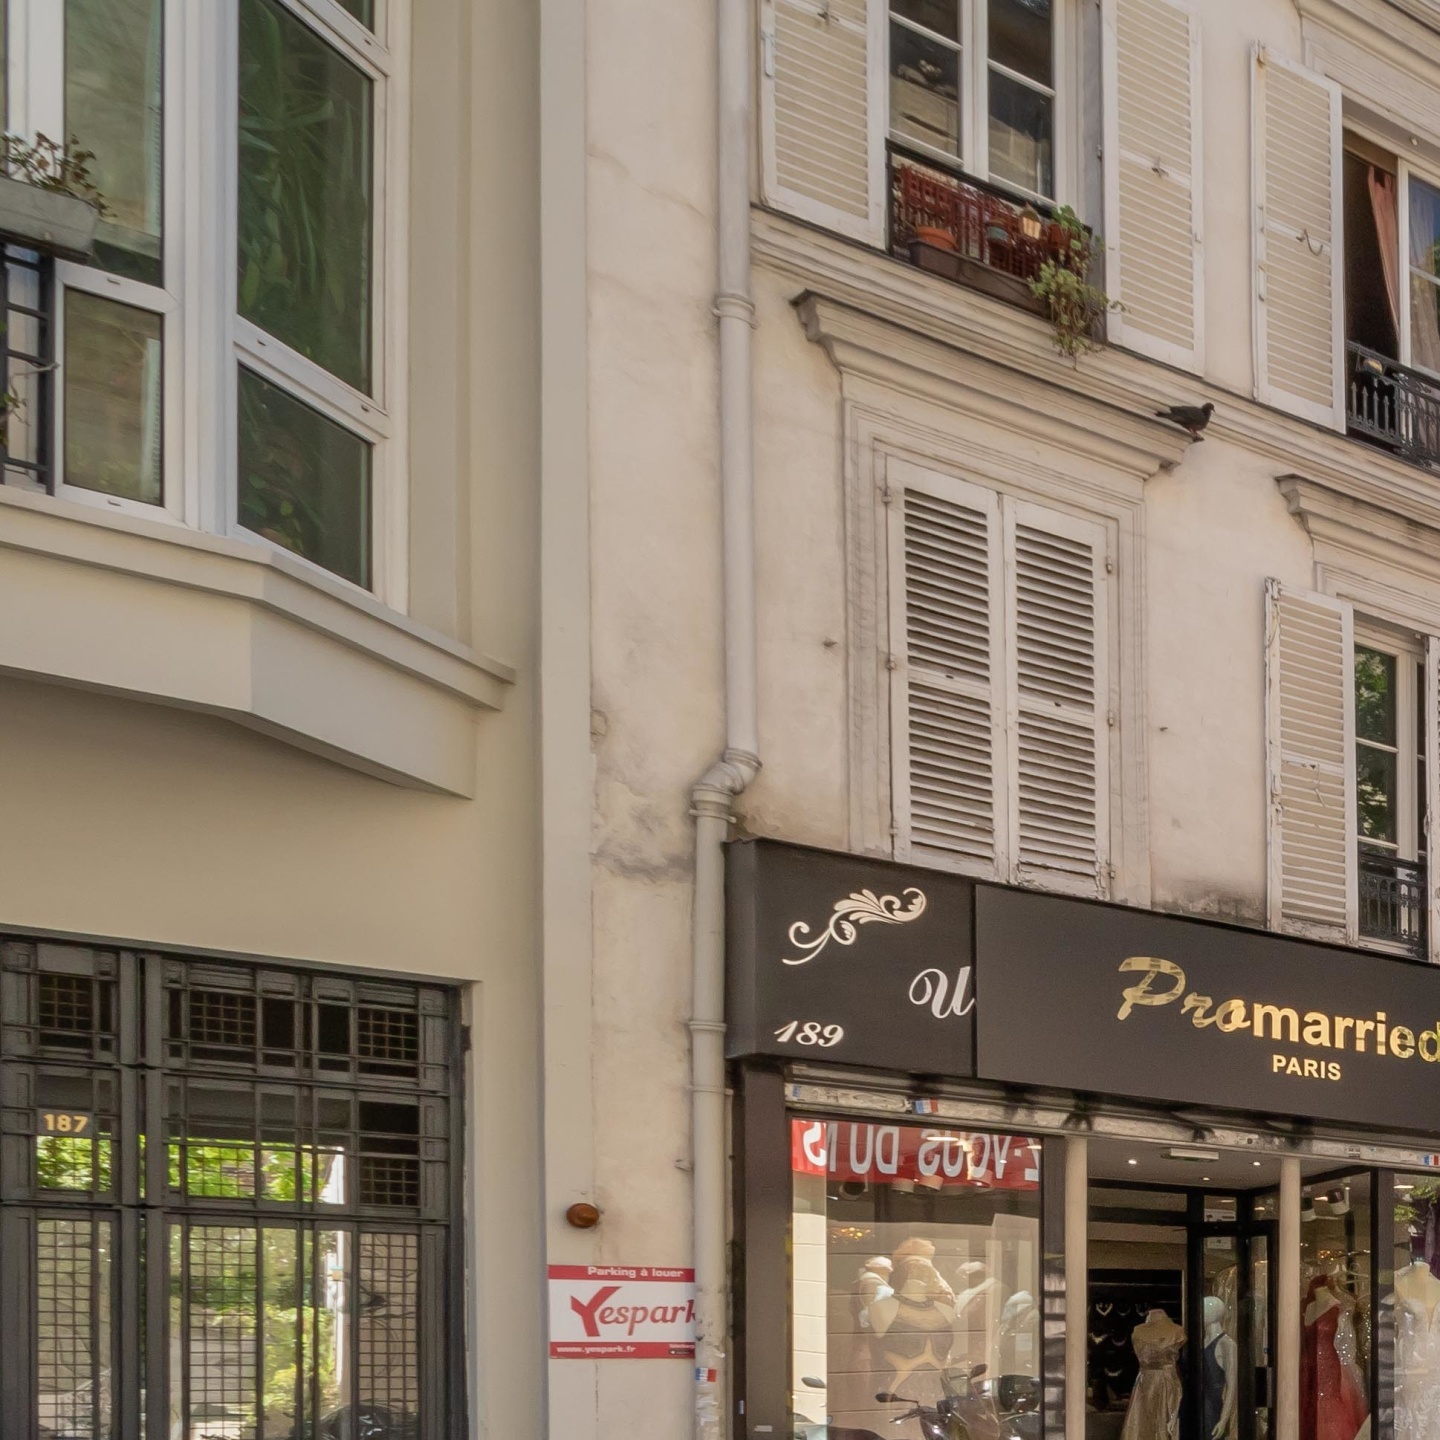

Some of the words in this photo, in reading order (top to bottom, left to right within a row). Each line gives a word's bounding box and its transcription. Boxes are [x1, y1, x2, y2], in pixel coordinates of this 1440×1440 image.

[773, 1019, 844, 1049] 189
[1272, 1053, 1342, 1082] PARIS
[43, 1113, 88, 1133] 187
[587, 1266, 636, 1279] Parking
[639, 1267, 649, 1277] à
[652, 1267, 684, 1278] louer
[570, 1286, 696, 1337] Yespark
[557, 1345, 636, 1355] www.yespark.fr
